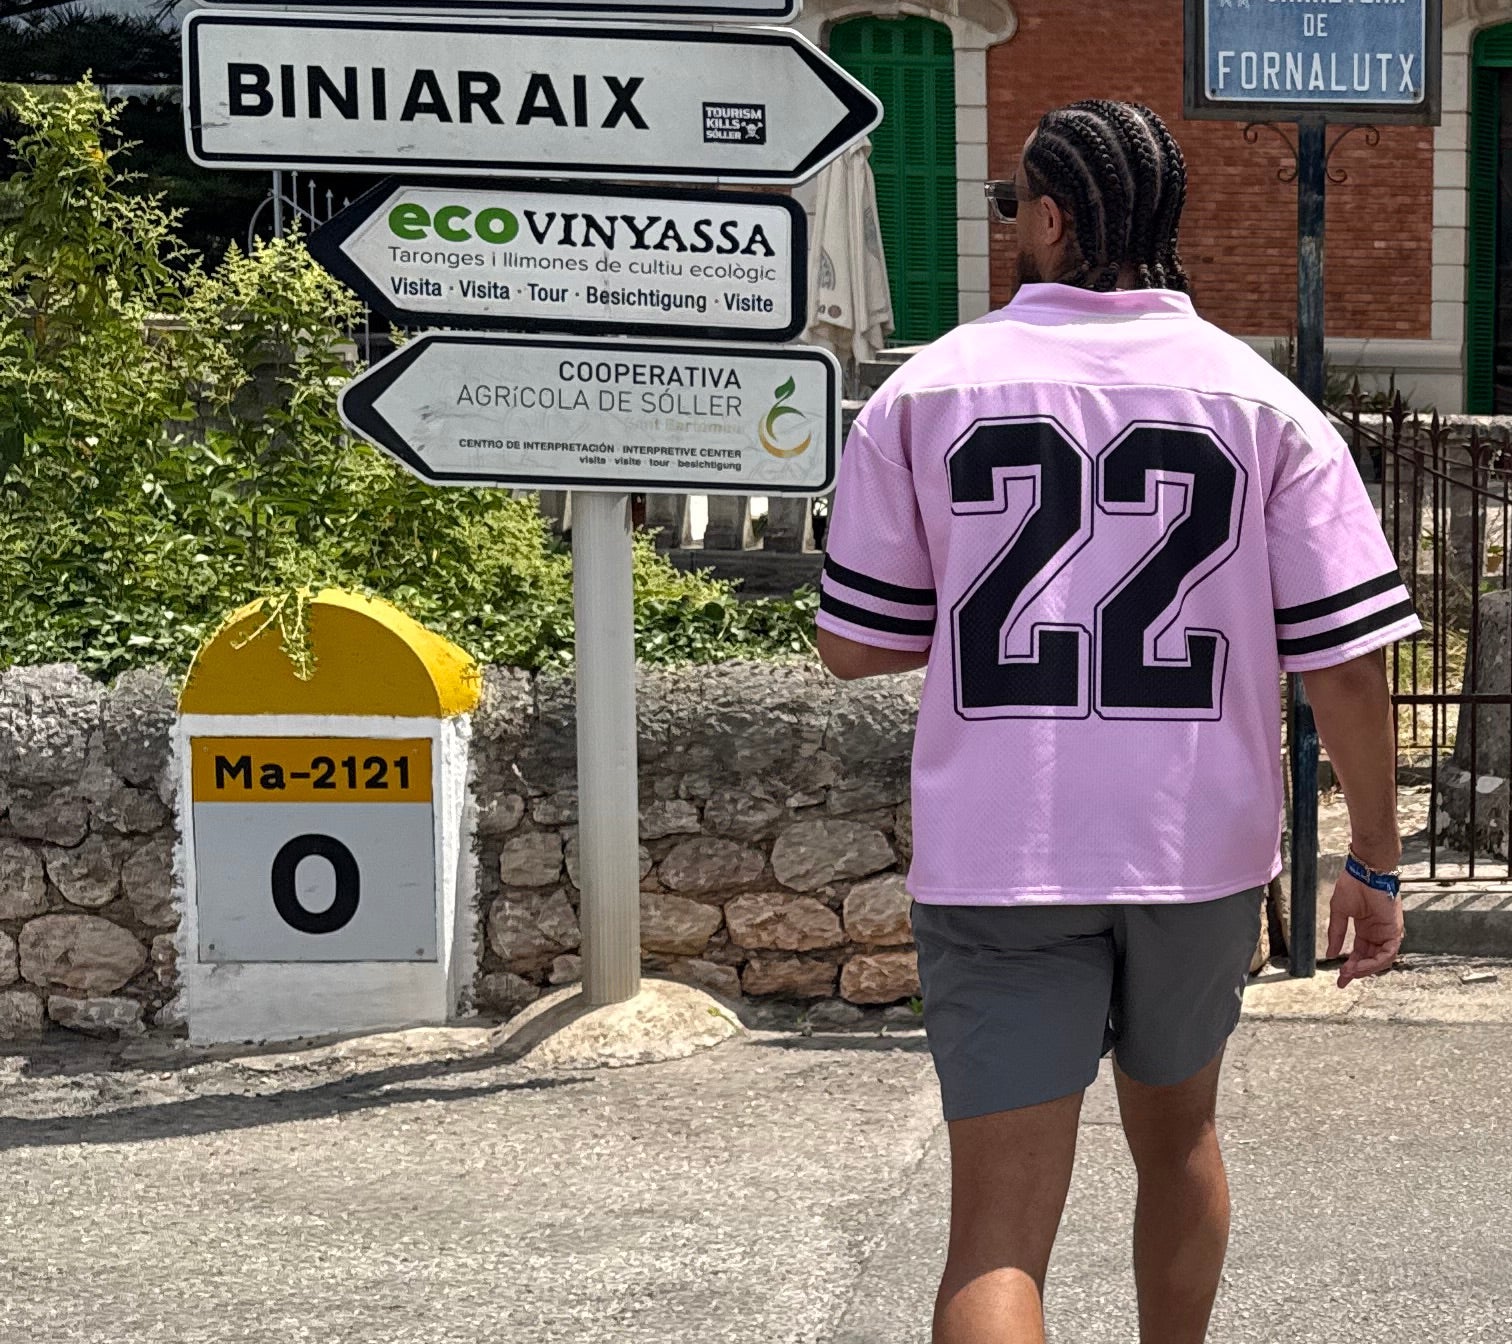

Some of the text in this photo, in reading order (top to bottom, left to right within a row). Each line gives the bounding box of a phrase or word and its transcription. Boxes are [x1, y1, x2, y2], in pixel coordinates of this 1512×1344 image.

[1303, 13, 1328, 37] DE
[1218, 51, 1414, 92] FORNALUTX
[227, 62, 650, 131] BINIARAIX
[705, 107, 762, 119] TOURISM
[706, 118, 740, 129] KILLS
[706, 129, 742, 140] SÓLLER
[388, 246, 777, 284] Taronges i llimones de cultiu ecològic
[390, 276, 774, 313] Visita Visita Tour Besichtigung Visite
[559, 360, 742, 389] COOPERATIVA
[599, 390, 633, 413] DE
[641, 388, 742, 417] SÓLLER
[459, 438, 742, 459] CENTRO DE INTERPRETACIÓN INTERPRETIVE CENTER
[649, 458, 670, 468] tour
[677, 459, 742, 472] besichtigung
[944, 414, 1249, 722] 22
[214, 755, 410, 790] Ma-2121
